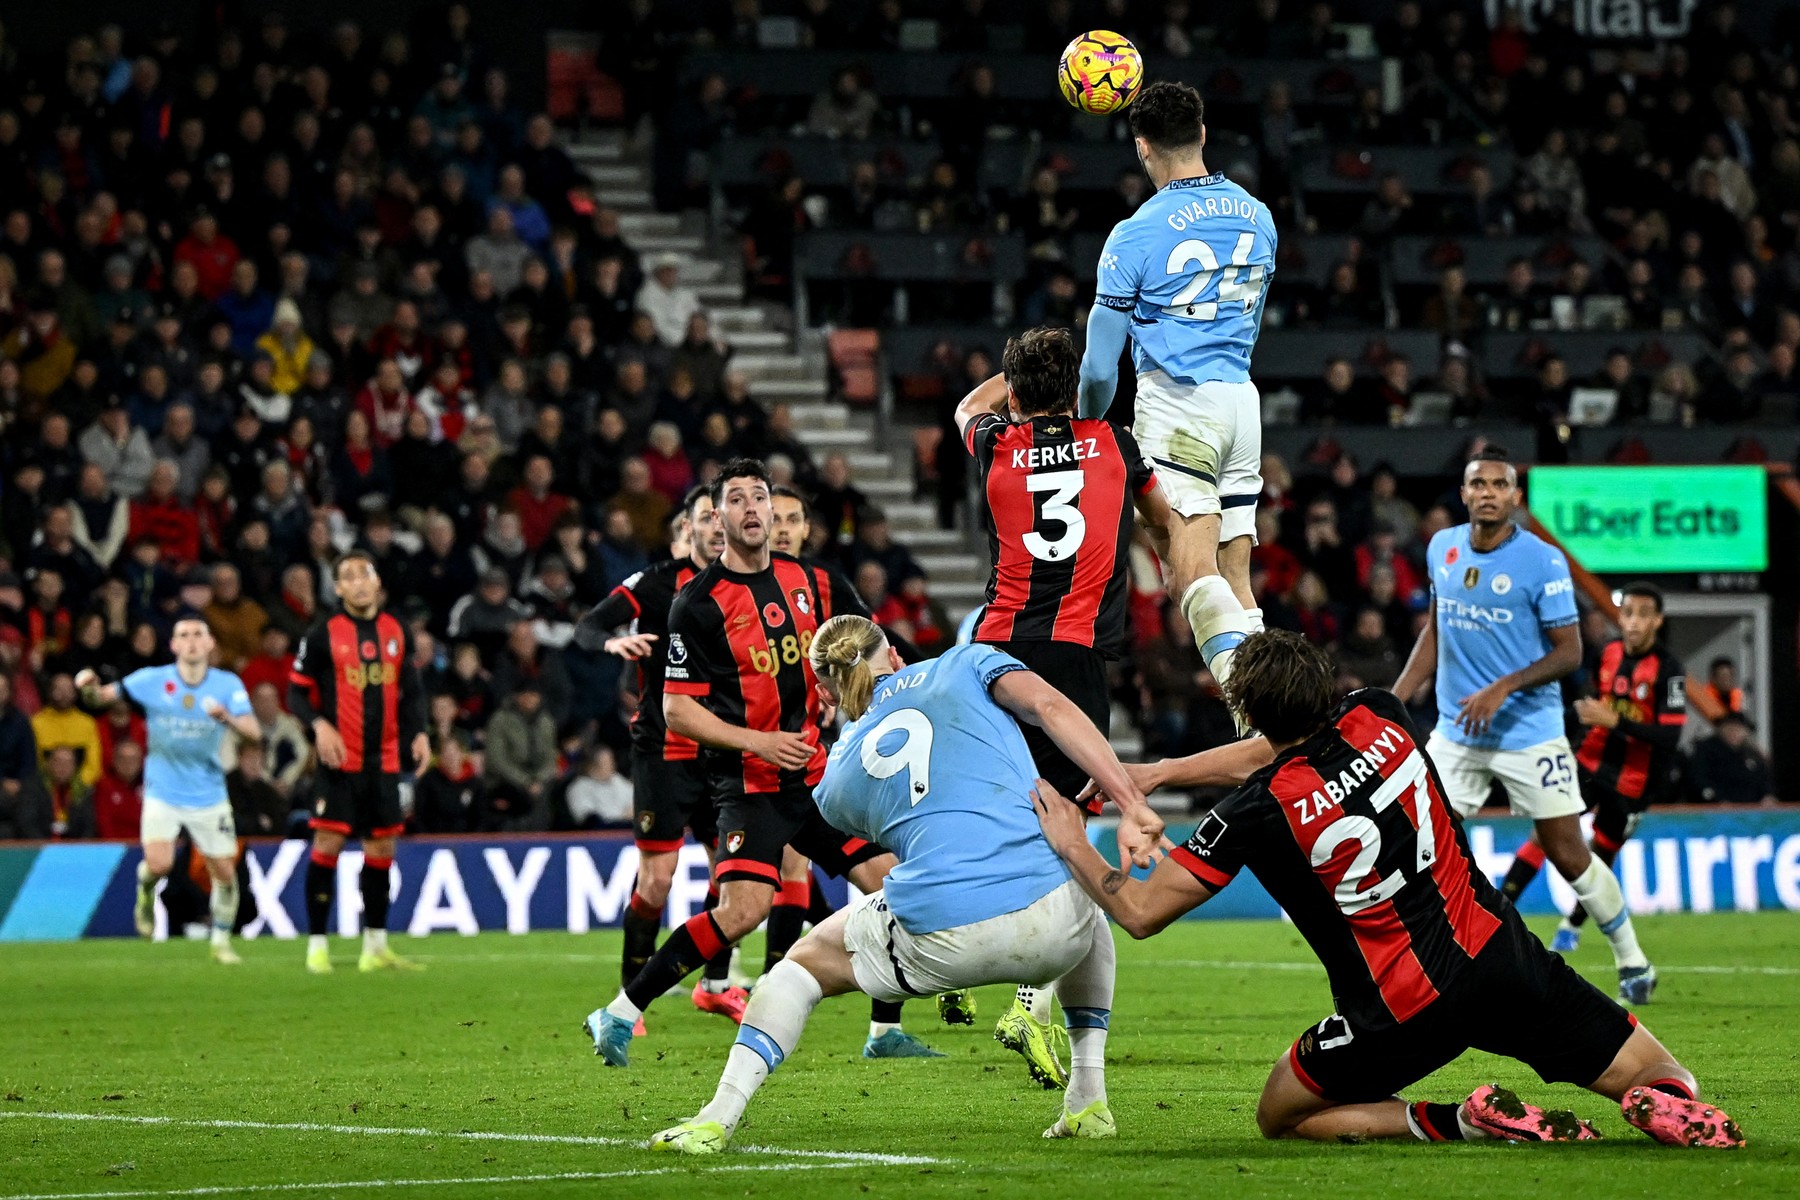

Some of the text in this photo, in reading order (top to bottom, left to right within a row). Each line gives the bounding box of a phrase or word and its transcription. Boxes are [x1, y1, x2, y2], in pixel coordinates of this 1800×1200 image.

[1167, 197, 1258, 232] GVARDIOL
[1161, 232, 1265, 321] 24
[1011, 437, 1101, 469] KERKEZ
[1021, 469, 1087, 562] 3
[1553, 501, 1740, 537] Uber Eats
[1436, 597, 1514, 624] ETIHAD
[749, 629, 813, 678] bj88
[860, 708, 934, 809] 9
[1293, 725, 1405, 826] ZABARNYI
[1536, 754, 1572, 788] 25
[1310, 748, 1437, 916] 27
